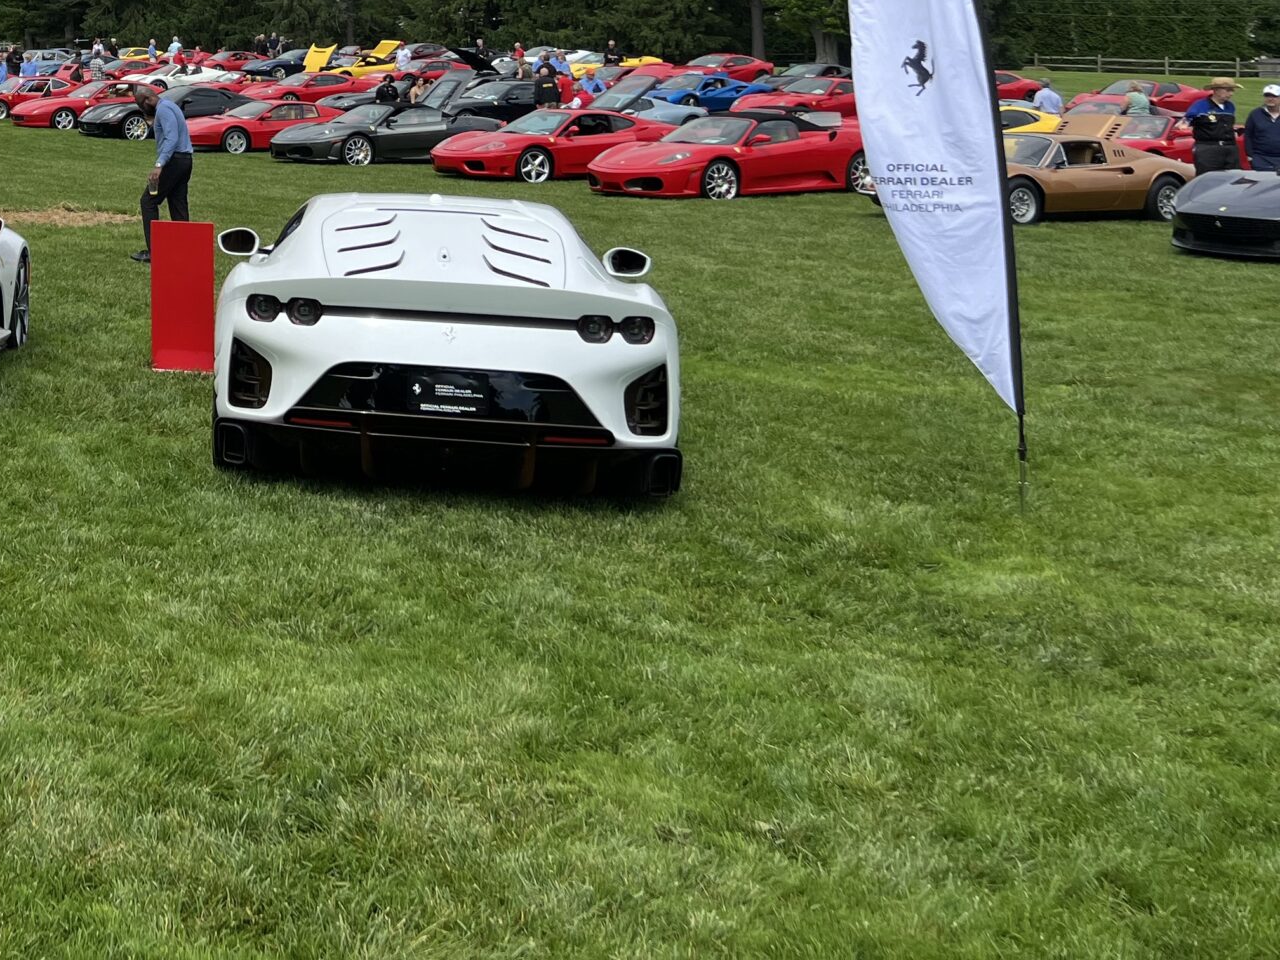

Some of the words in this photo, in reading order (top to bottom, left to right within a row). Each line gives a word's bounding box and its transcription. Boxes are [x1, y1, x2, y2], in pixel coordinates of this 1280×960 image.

[886, 163, 948, 172] OFFICIAL
[872, 176, 917, 186] ERRARI
[920, 176, 973, 186] DEALER
[891, 189, 943, 199] FERRARI
